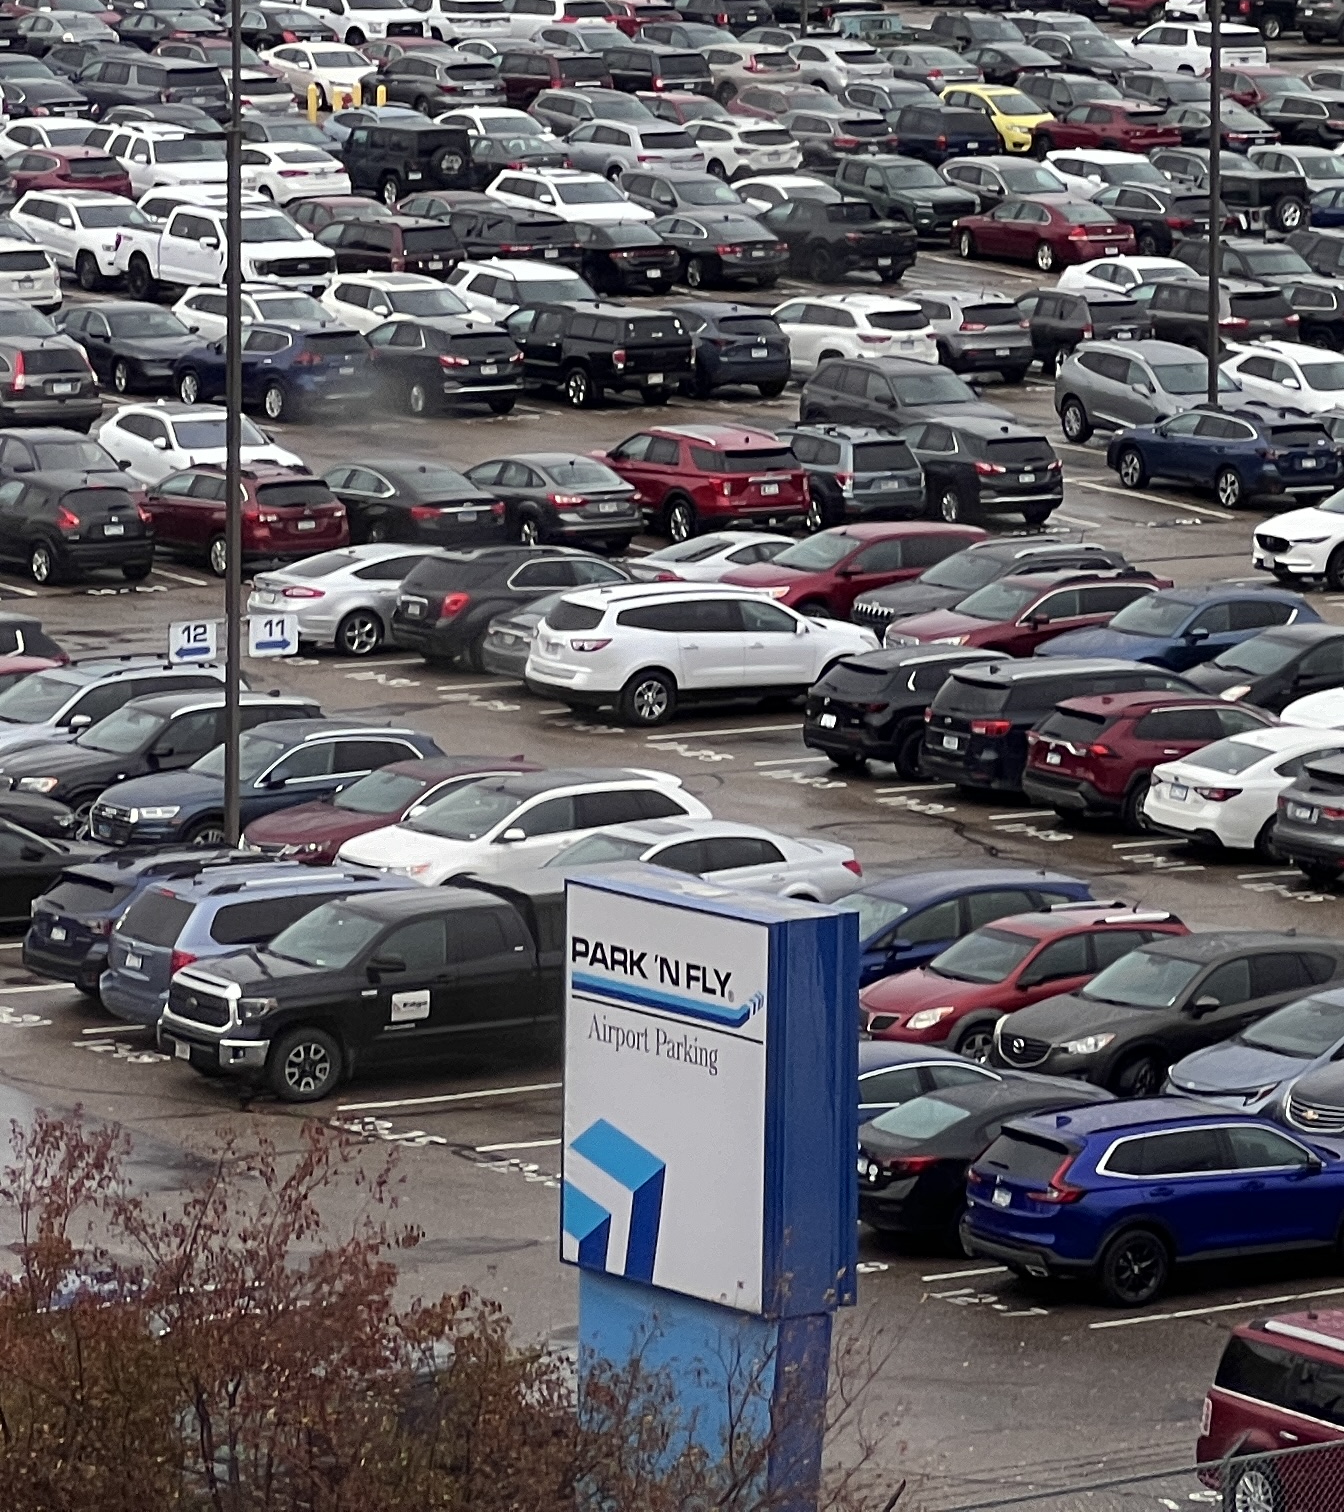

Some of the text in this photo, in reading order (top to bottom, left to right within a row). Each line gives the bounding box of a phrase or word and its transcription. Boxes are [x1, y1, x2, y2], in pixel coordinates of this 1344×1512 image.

[182, 624, 207, 643] 12
[264, 619, 285, 637] 11
[571, 935, 648, 980] PARK
[686, 962, 732, 998] FLY
[588, 1012, 719, 1077] Airport Parking
